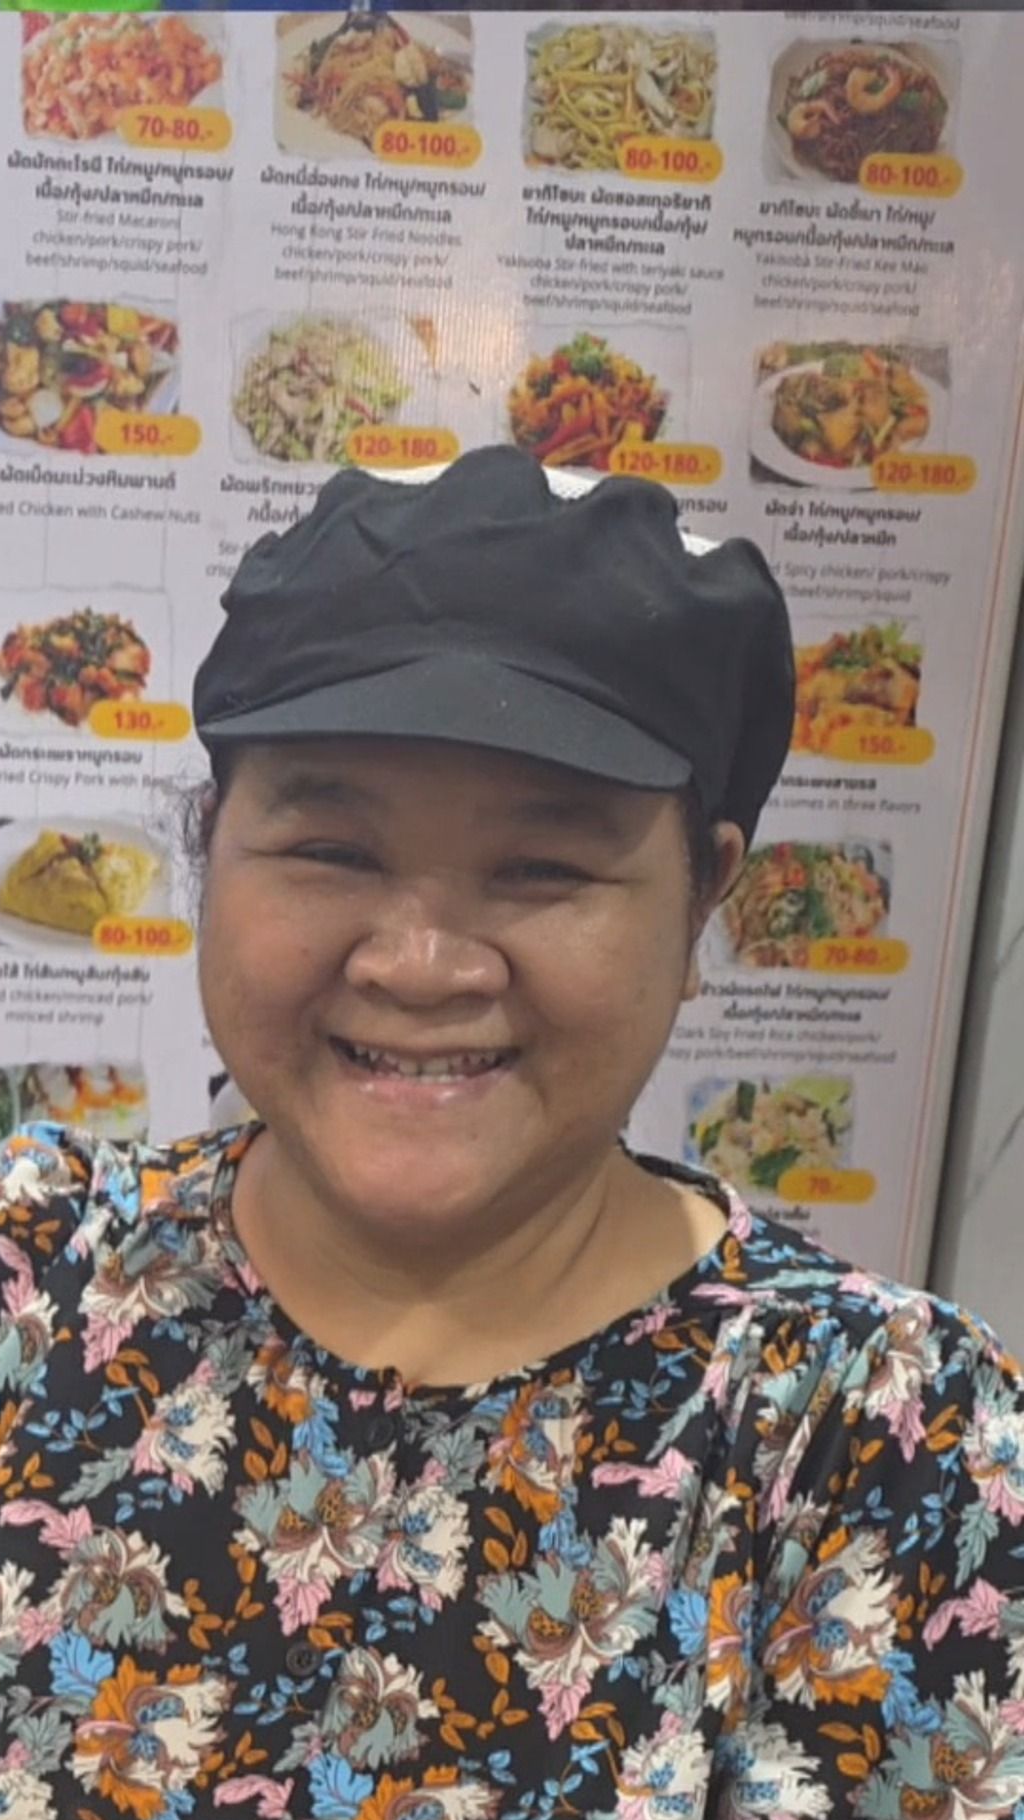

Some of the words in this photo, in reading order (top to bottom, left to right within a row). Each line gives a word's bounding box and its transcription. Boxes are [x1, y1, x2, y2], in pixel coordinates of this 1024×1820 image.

[270, 222, 305, 240] Hong
[309, 222, 343, 243] Kong
[611, 259, 638, 274] with
[689, 267, 724, 280] sauce
[220, 474, 322, 496] ผัดพริกหยว
[18, 501, 73, 518] Chicken
[77, 504, 107, 520] with
[110, 505, 164, 522] Cashew
[167, 509, 200, 525] Nuts
[28, 770, 70, 789] Crispy
[74, 771, 103, 786] Pork
[109, 773, 138, 788] with
[5, 1009, 54, 1024] minced
